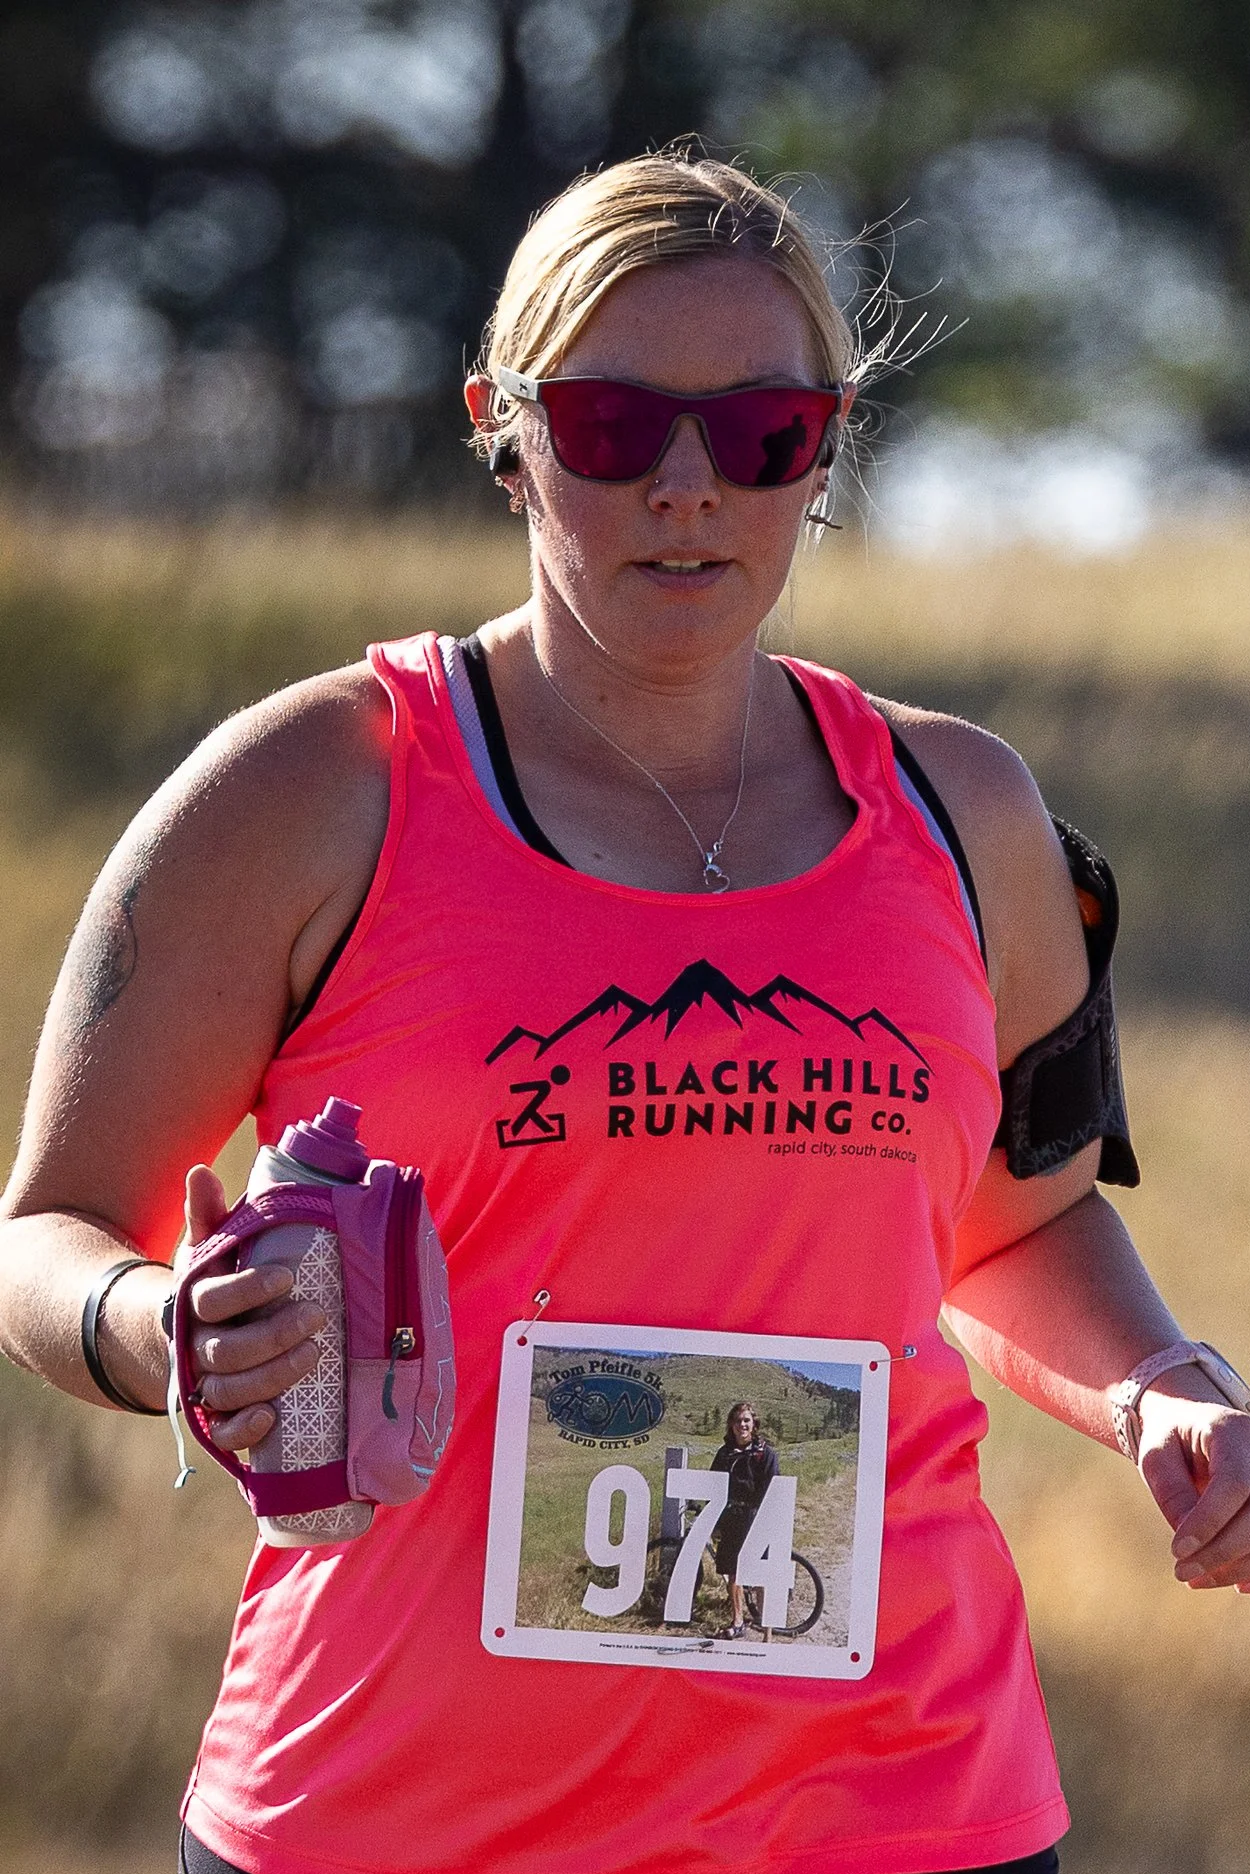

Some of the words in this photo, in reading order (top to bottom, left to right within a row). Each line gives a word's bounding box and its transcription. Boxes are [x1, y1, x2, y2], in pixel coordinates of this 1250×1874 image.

[608, 1059, 779, 1097] BLACK
[803, 1057, 930, 1103] HILLS
[607, 1099, 852, 1139] RUNNING
[871, 1109, 911, 1136] CO.
[767, 1141, 807, 1156] rapid
[810, 1141, 838, 1157] city,
[840, 1143, 877, 1157] south
[880, 1145, 918, 1163] dakota
[548, 1364, 586, 1384] Tom
[588, 1358, 641, 1380] Pfeifle
[558, 1429, 597, 1449] RAPID
[632, 1433, 651, 1446] SD
[582, 1463, 798, 1629] 974
